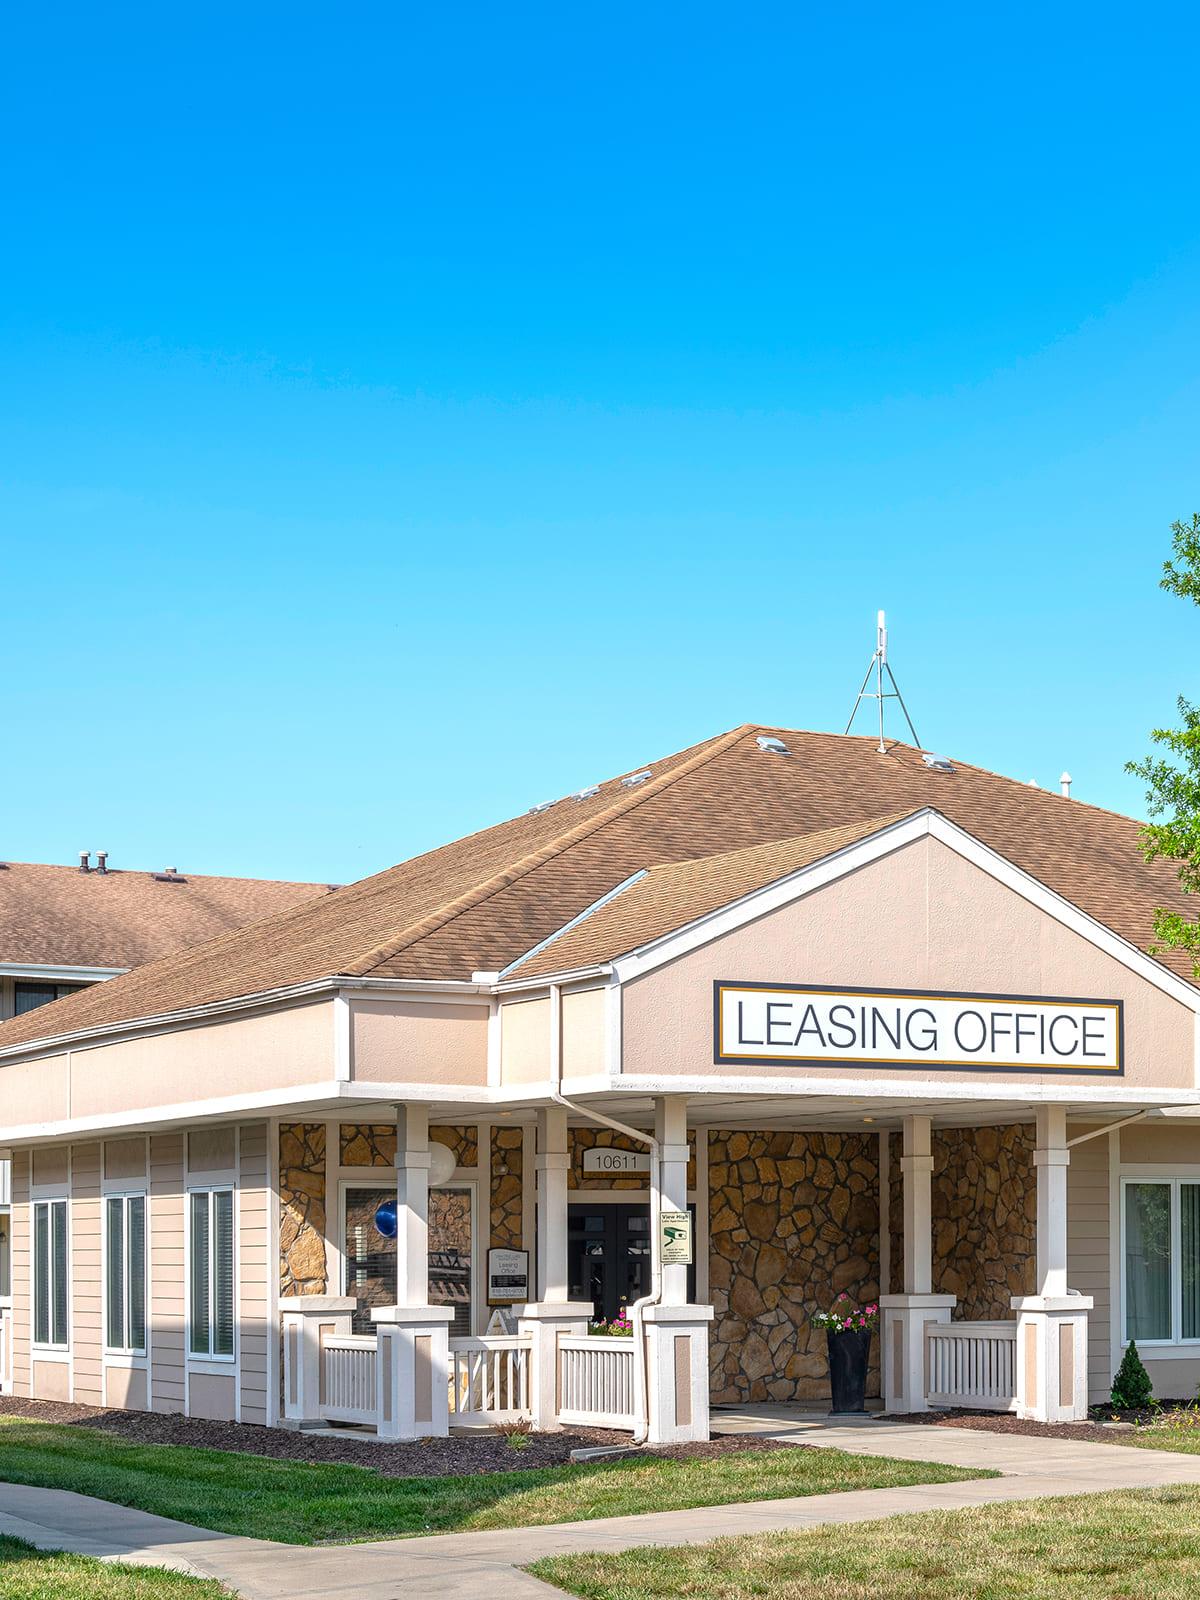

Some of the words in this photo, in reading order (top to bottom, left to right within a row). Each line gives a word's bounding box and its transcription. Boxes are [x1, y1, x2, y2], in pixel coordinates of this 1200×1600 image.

[737, 1000, 938, 1052] LEASING
[954, 1010, 1106, 1057] OFFICE
[596, 1155, 637, 1169] 10611
